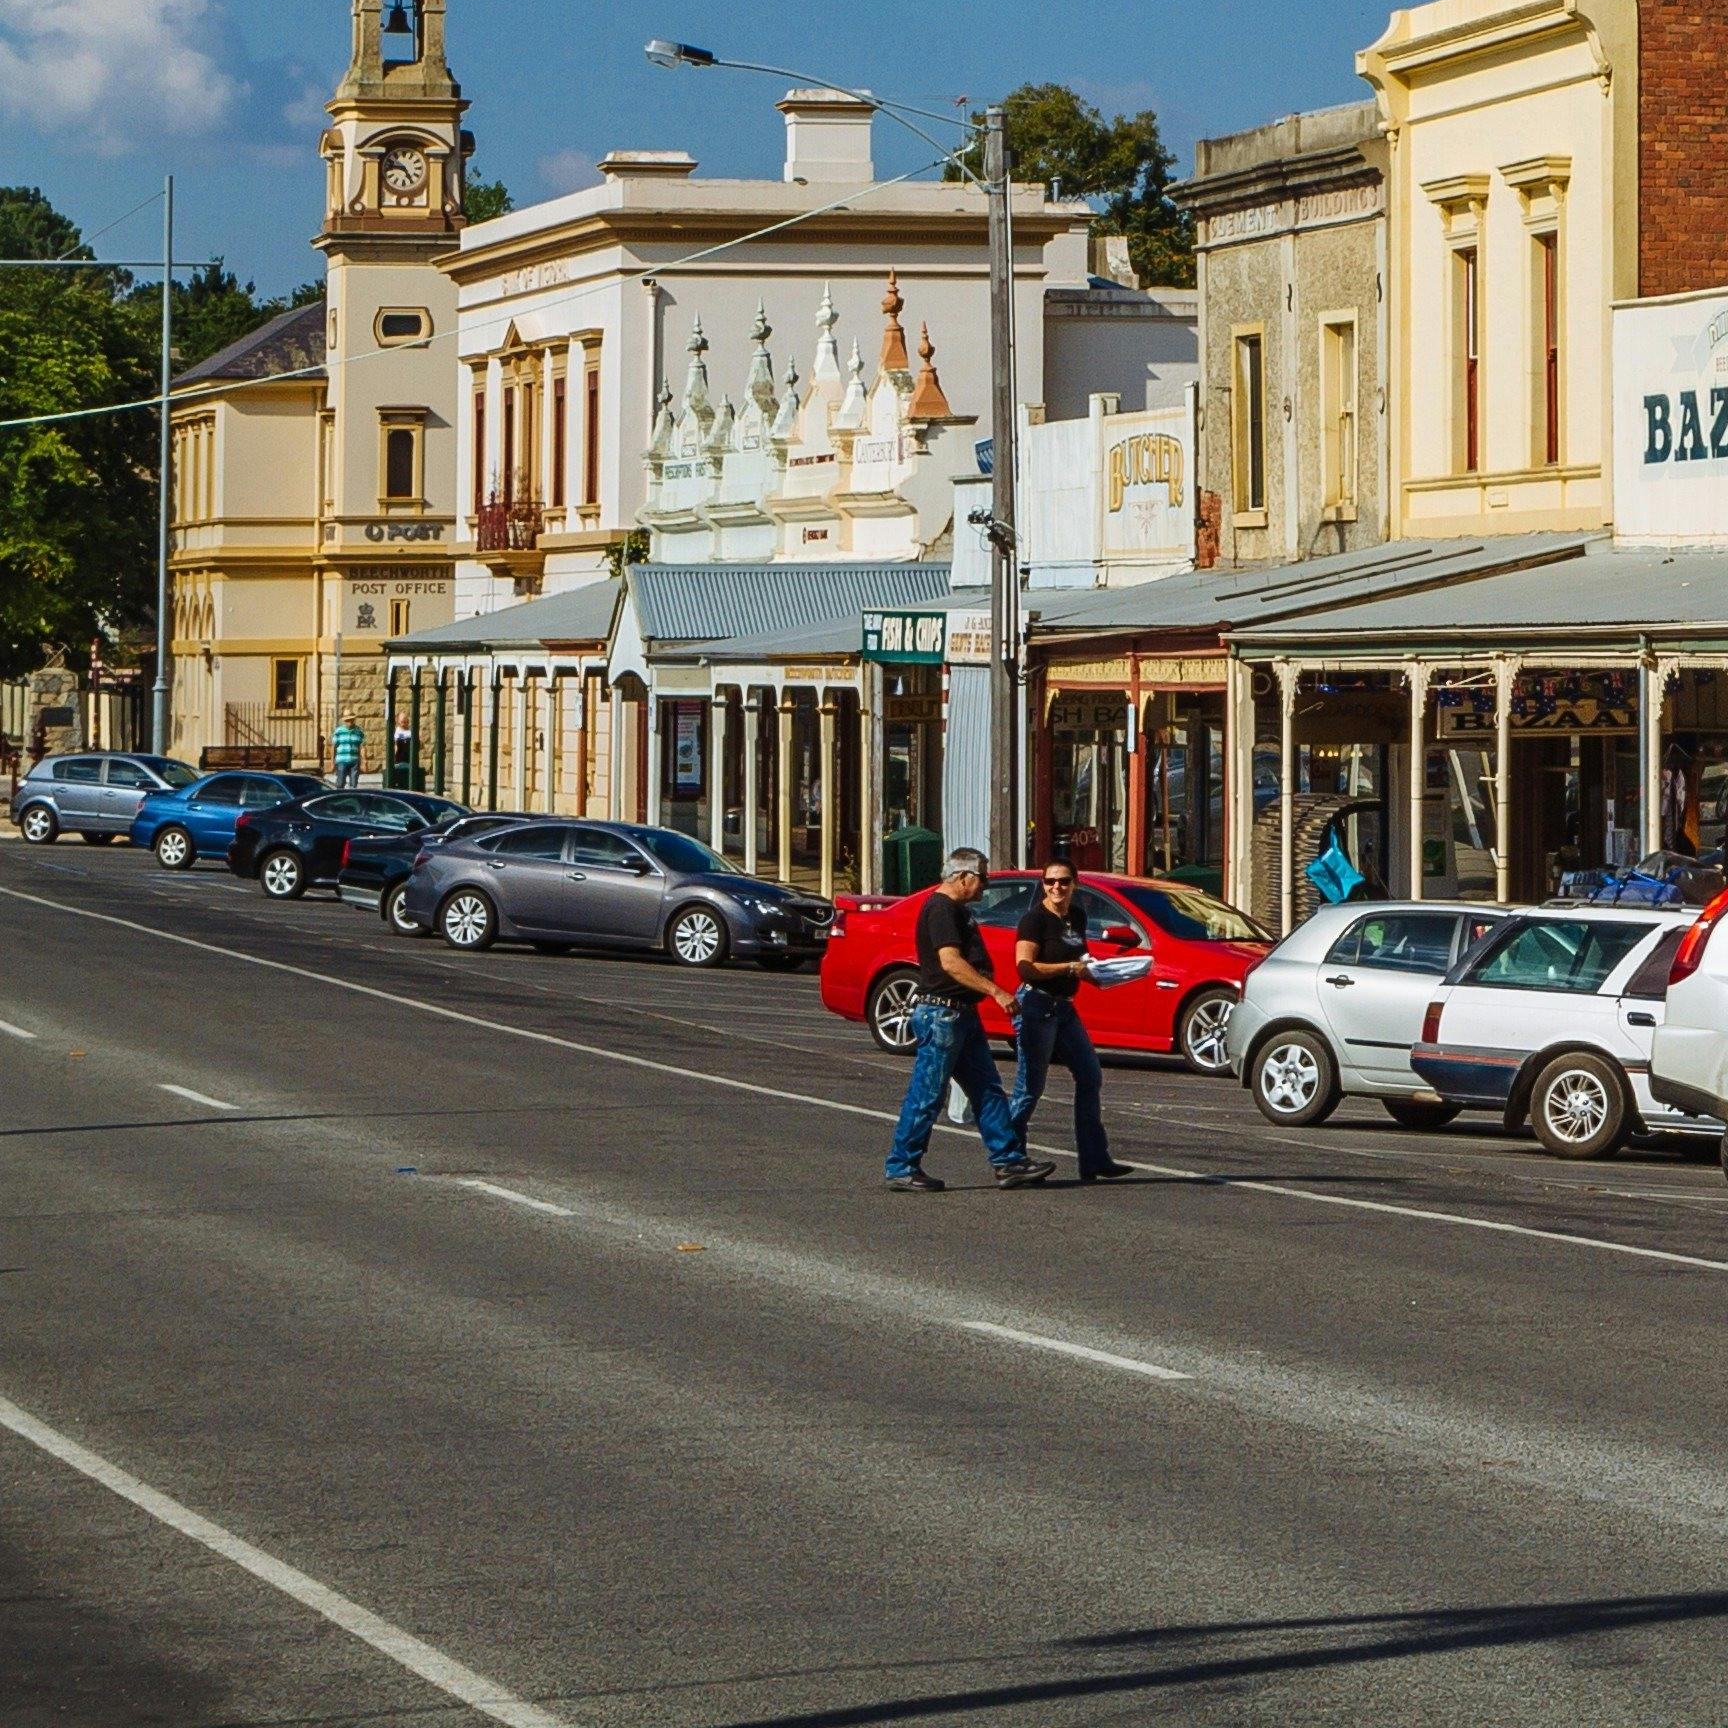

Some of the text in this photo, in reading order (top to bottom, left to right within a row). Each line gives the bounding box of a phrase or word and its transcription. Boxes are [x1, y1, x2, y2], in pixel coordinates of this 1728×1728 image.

[1301, 185, 1379, 221] BUILDINGS
[1109, 433, 1184, 513] BUTCHER
[387, 523, 444, 542] POST
[348, 566, 451, 580] BEECHWORTH
[352, 582, 447, 595] POST OFFICE
[882, 617, 902, 651] FISH
[905, 617, 913, 651] &
[916, 617, 943, 652] CHIPS
[1029, 706, 1083, 723] FSH
[1450, 710, 1639, 728] BZAA
